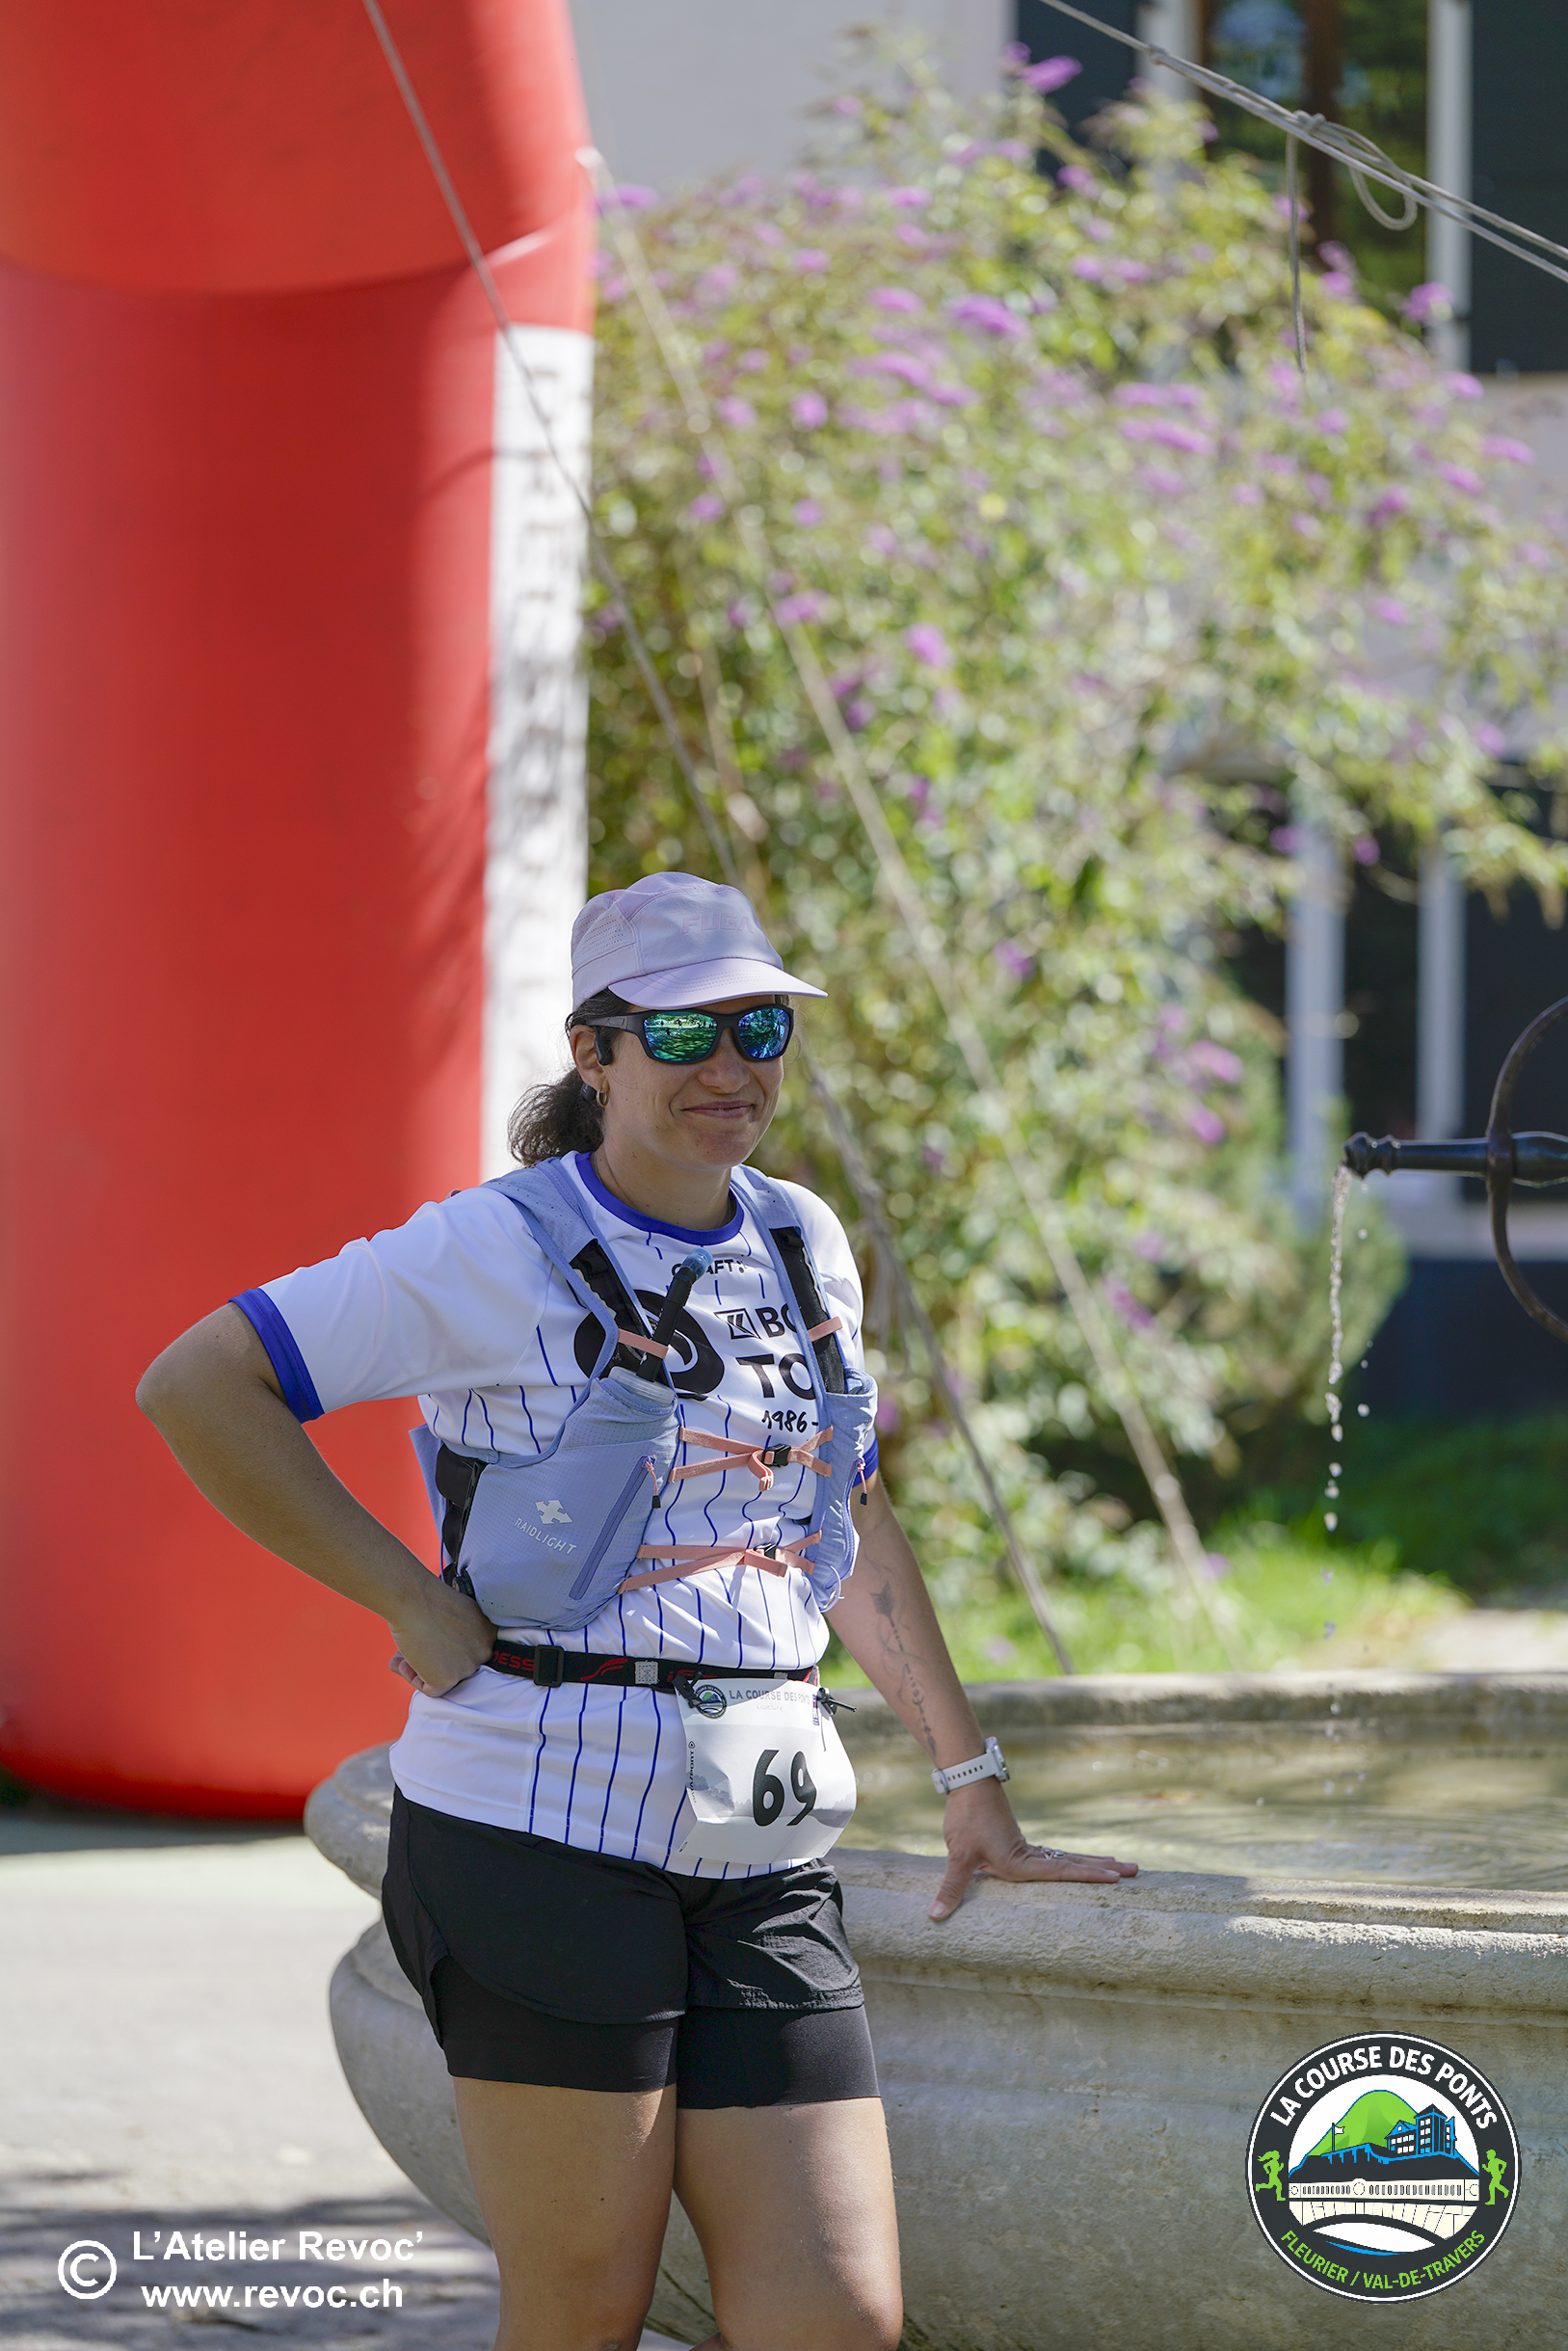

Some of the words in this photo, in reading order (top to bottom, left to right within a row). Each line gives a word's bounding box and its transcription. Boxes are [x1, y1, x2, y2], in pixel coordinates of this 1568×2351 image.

[672, 1259, 733, 1275] CAFT
[513, 1517, 577, 1555] RAIDLIGHT
[729, 1690, 744, 1699] LA
[745, 1690, 782, 1700] COURSE
[784, 1692, 798, 1702] DES
[753, 1749, 817, 1828] 69
